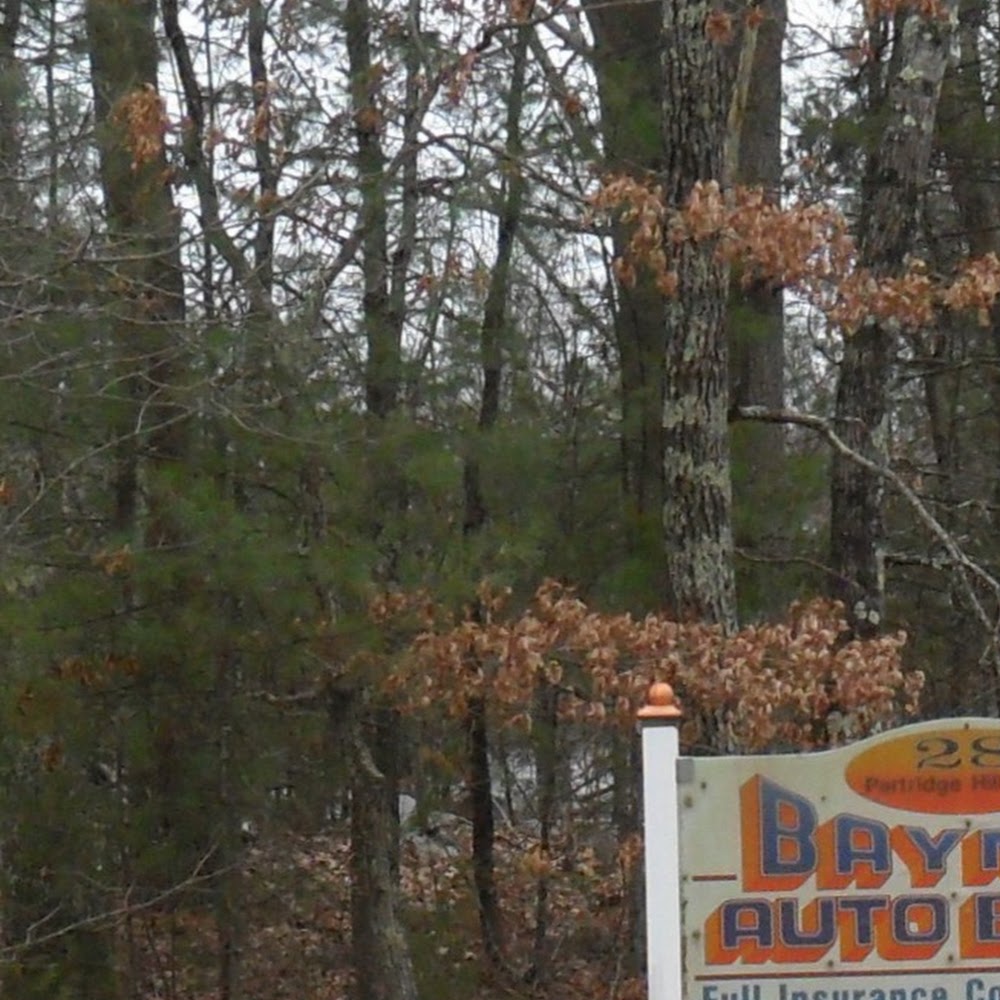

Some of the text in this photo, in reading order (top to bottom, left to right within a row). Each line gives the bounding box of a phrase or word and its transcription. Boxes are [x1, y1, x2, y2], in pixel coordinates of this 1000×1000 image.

[864, 775, 962, 795] Partridge
[972, 774, 1000, 791] Hill
[704, 894, 950, 965] AUTO
